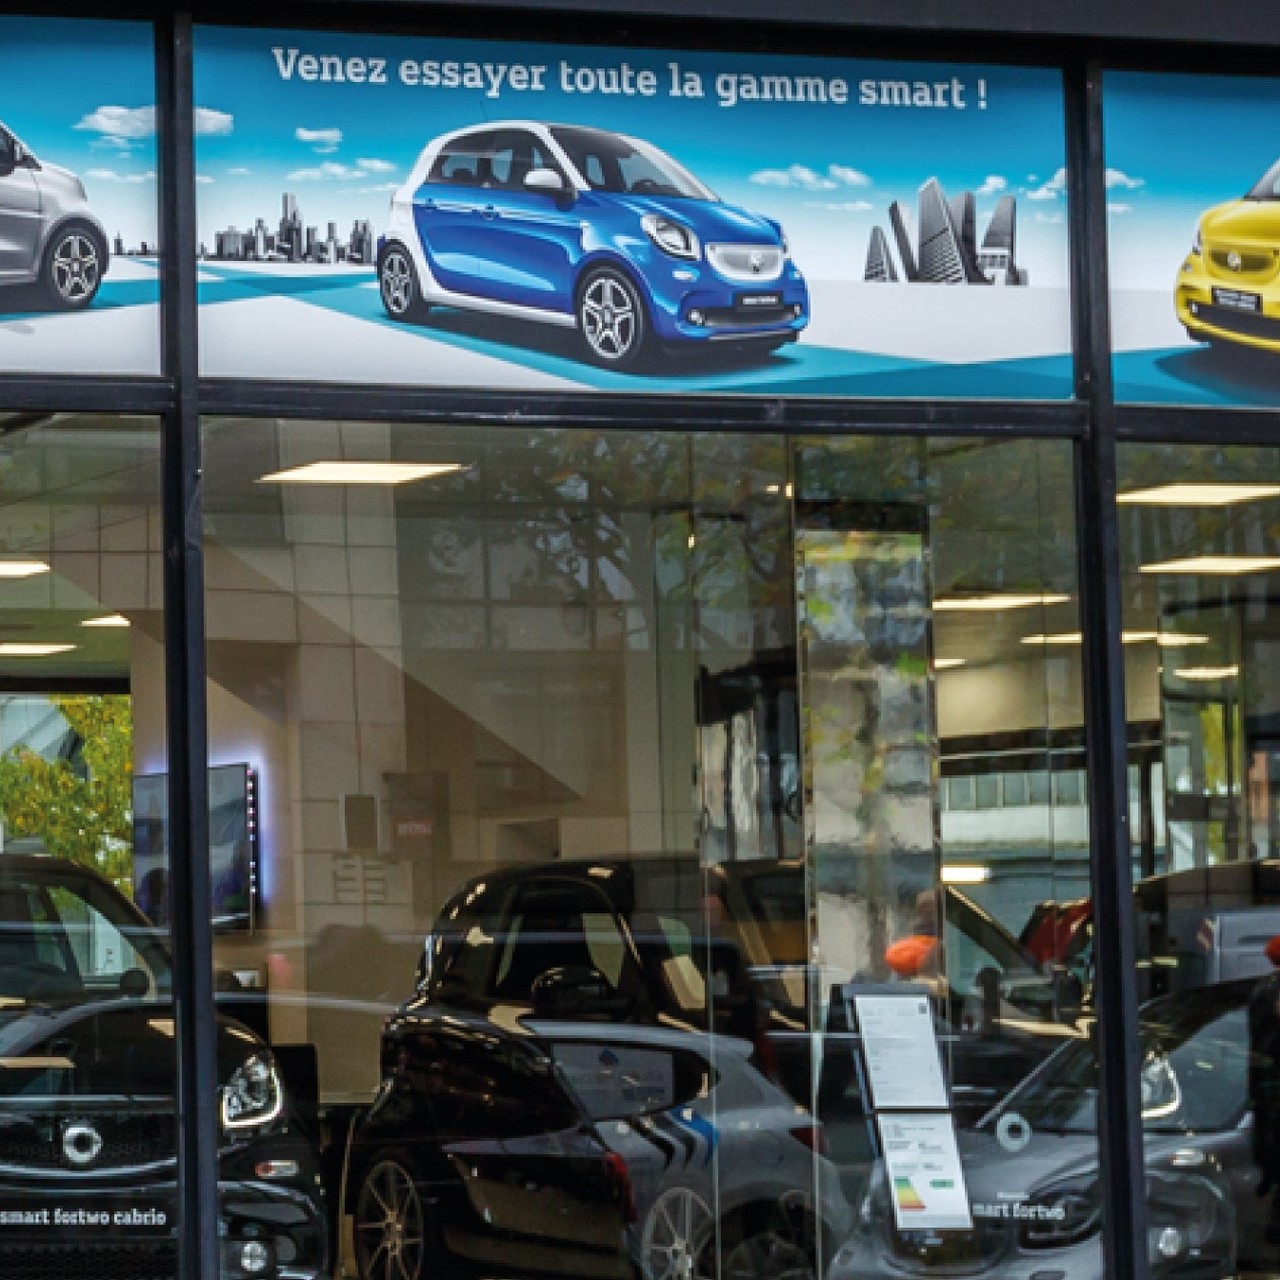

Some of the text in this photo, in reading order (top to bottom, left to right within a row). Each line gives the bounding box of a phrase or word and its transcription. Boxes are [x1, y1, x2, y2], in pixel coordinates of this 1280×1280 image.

[271, 47, 387, 83] Venez
[398, 60, 546, 98] essayer
[560, 62, 657, 95] toute
[667, 63, 704, 98] la
[716, 71, 849, 106] gamme
[858, 77, 966, 109] smart
[54, 1206, 111, 1225] fortwo
[113, 1207, 167, 1226] cabrio
